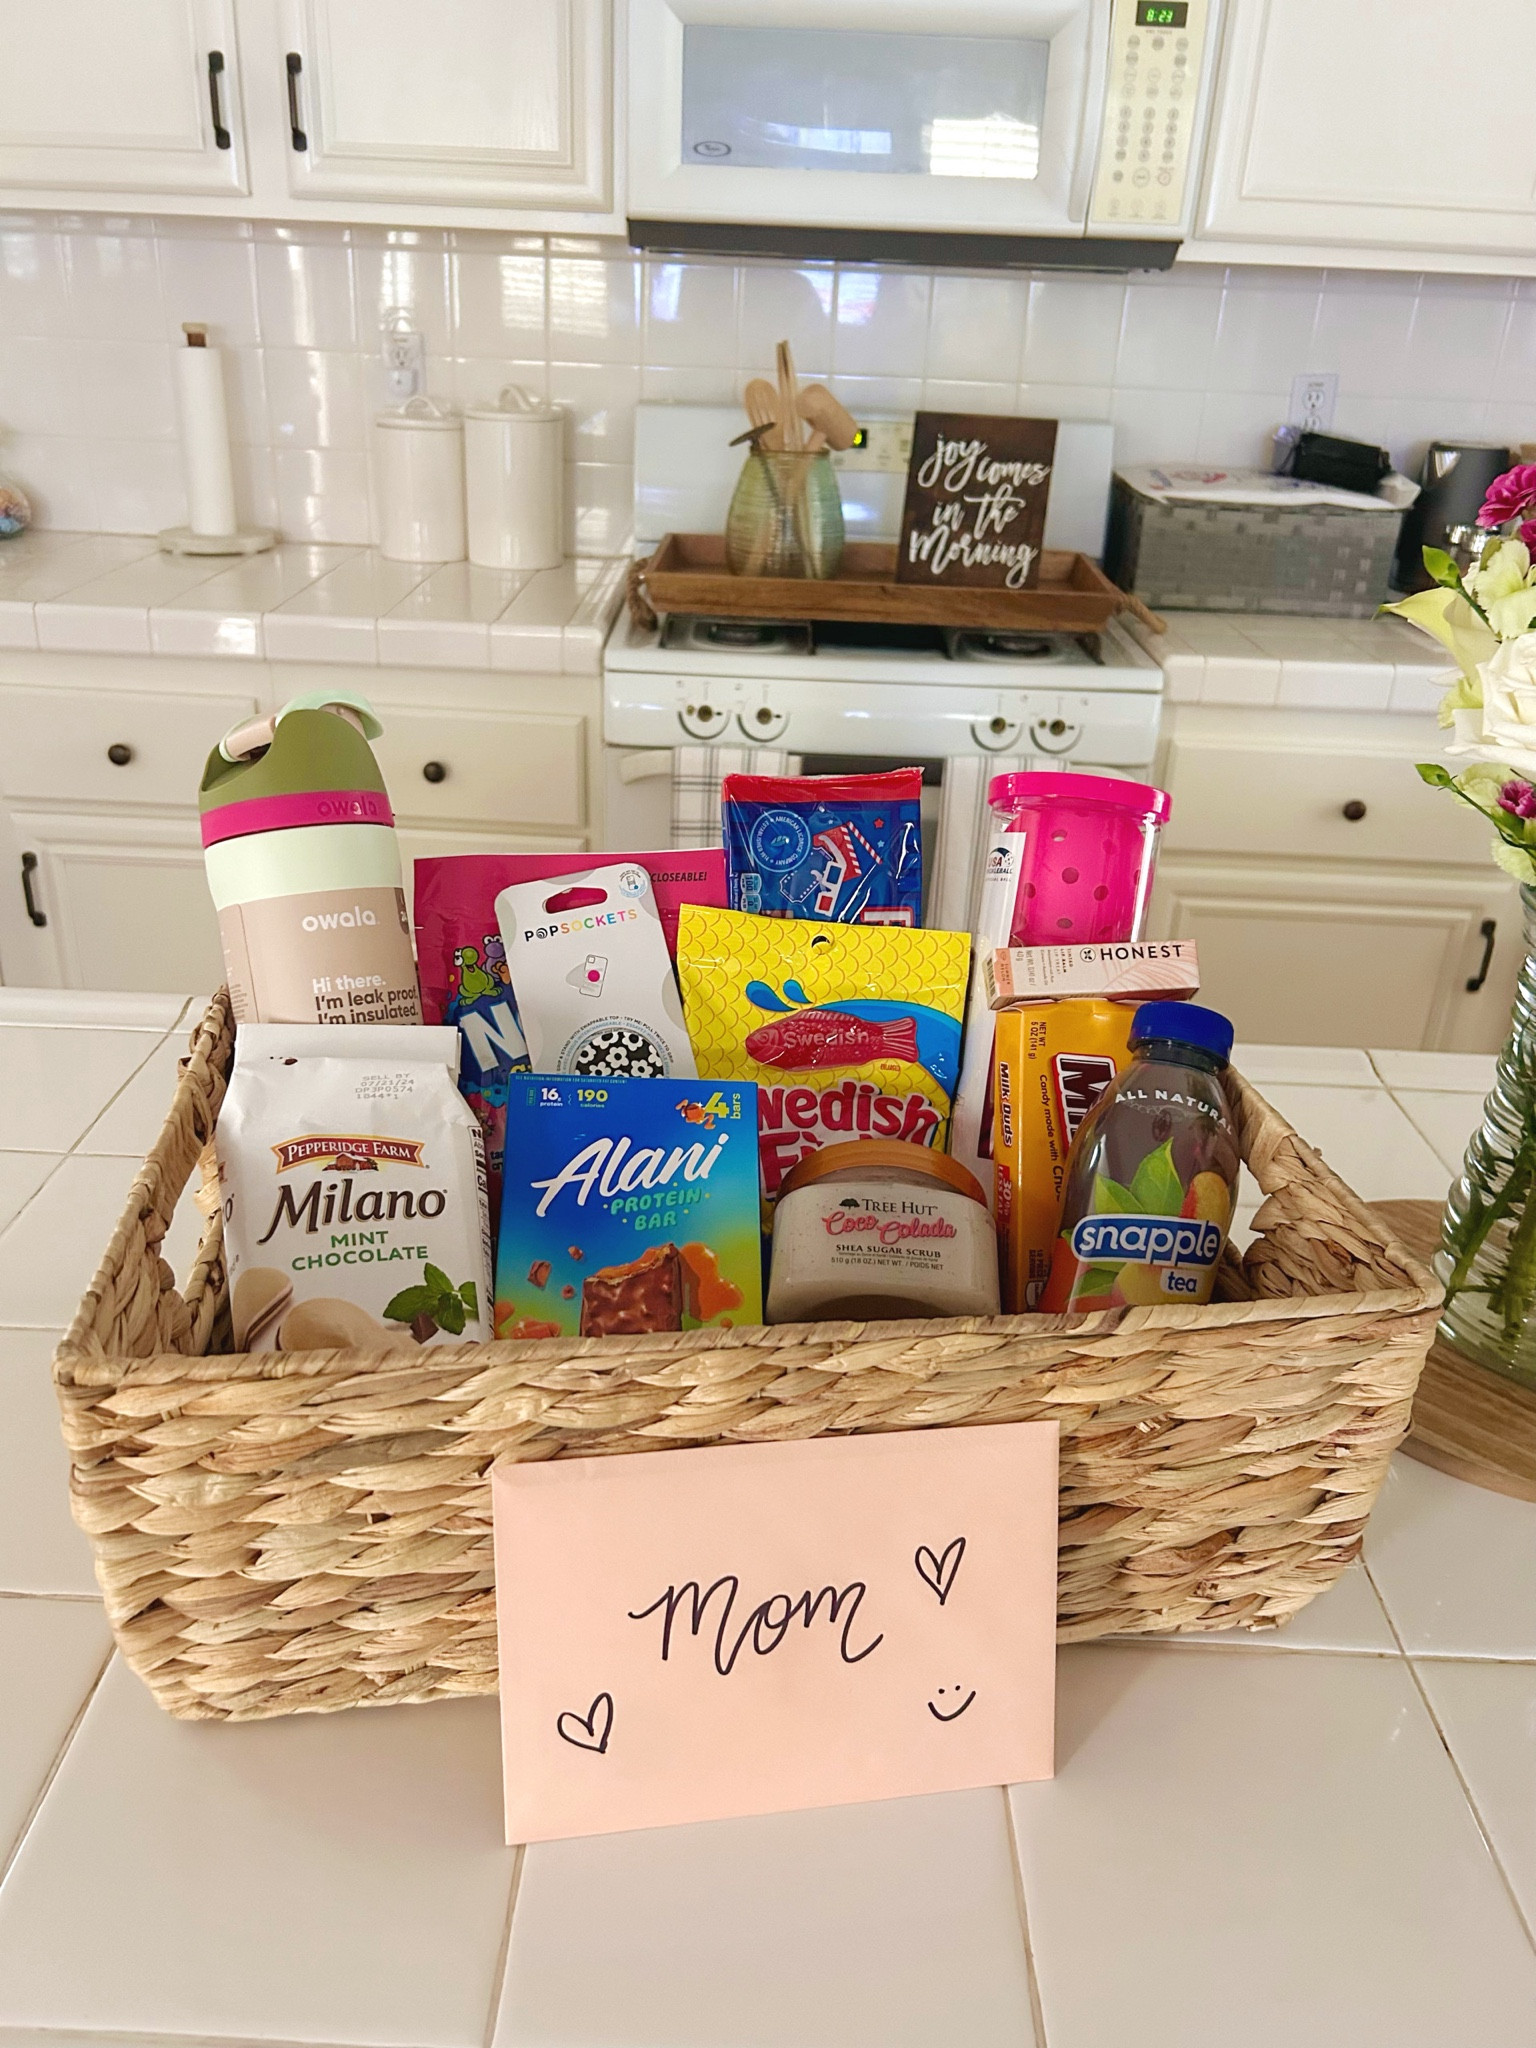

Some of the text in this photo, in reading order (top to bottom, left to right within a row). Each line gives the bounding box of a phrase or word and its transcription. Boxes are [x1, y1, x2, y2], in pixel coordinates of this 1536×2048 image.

[1146, 8, 1173, 23] 8:23
[918, 432, 1051, 492] joy comes
[932, 483, 1026, 540] in the
[909, 524, 1039, 589] Morning
[317, 796, 378, 816] owala
[650, 872, 708, 882] CLOSEABLE!
[301, 905, 377, 932] owala
[524, 908, 638, 942] POPSOCKETS
[1100, 945, 1182, 961] HONEST
[312, 975, 387, 994] Hi there.
[316, 985, 418, 1010] I'm leak proof.
[318, 1002, 419, 1024] I'm insulated.
[783, 1028, 870, 1048] Swedish
[1030, 1027, 1038, 1036] OZ
[1038, 1022, 1047, 1047] NET WT
[360, 1079, 414, 1087] 07/21/24
[577, 1089, 608, 1102] 190
[1040, 1074, 1051, 1106] Candy
[703, 1091, 730, 1119] 4
[730, 1092, 742, 1120] bars
[757, 1081, 939, 1146] wedish
[1000, 1062, 1012, 1147] Milk Duds
[1115, 1088, 1232, 1135] ALL NATURAL
[1044, 1108, 1055, 1138] made
[287, 1140, 412, 1163] PEPPERIDGE FARM
[1049, 1140, 1059, 1161] with
[531, 1132, 730, 1218] Alani
[257, 1178, 447, 1246] Milano
[610, 1187, 703, 1216] PROTEIN
[861, 1198, 936, 1216] TREE HUT
[634, 1211, 677, 1231] BAR
[822, 1211, 957, 1245] Coco Colada
[330, 1230, 389, 1248] MINT
[836, 1244, 864, 1252] SHEA
[866, 1246, 903, 1255] SUGAR
[906, 1248, 942, 1258] SCRUB
[1079, 1219, 1220, 1267] snapple
[291, 1246, 429, 1271] CHOCOLATE
[1166, 1271, 1198, 1293] tea
[627, 1575, 884, 1676] Mom
